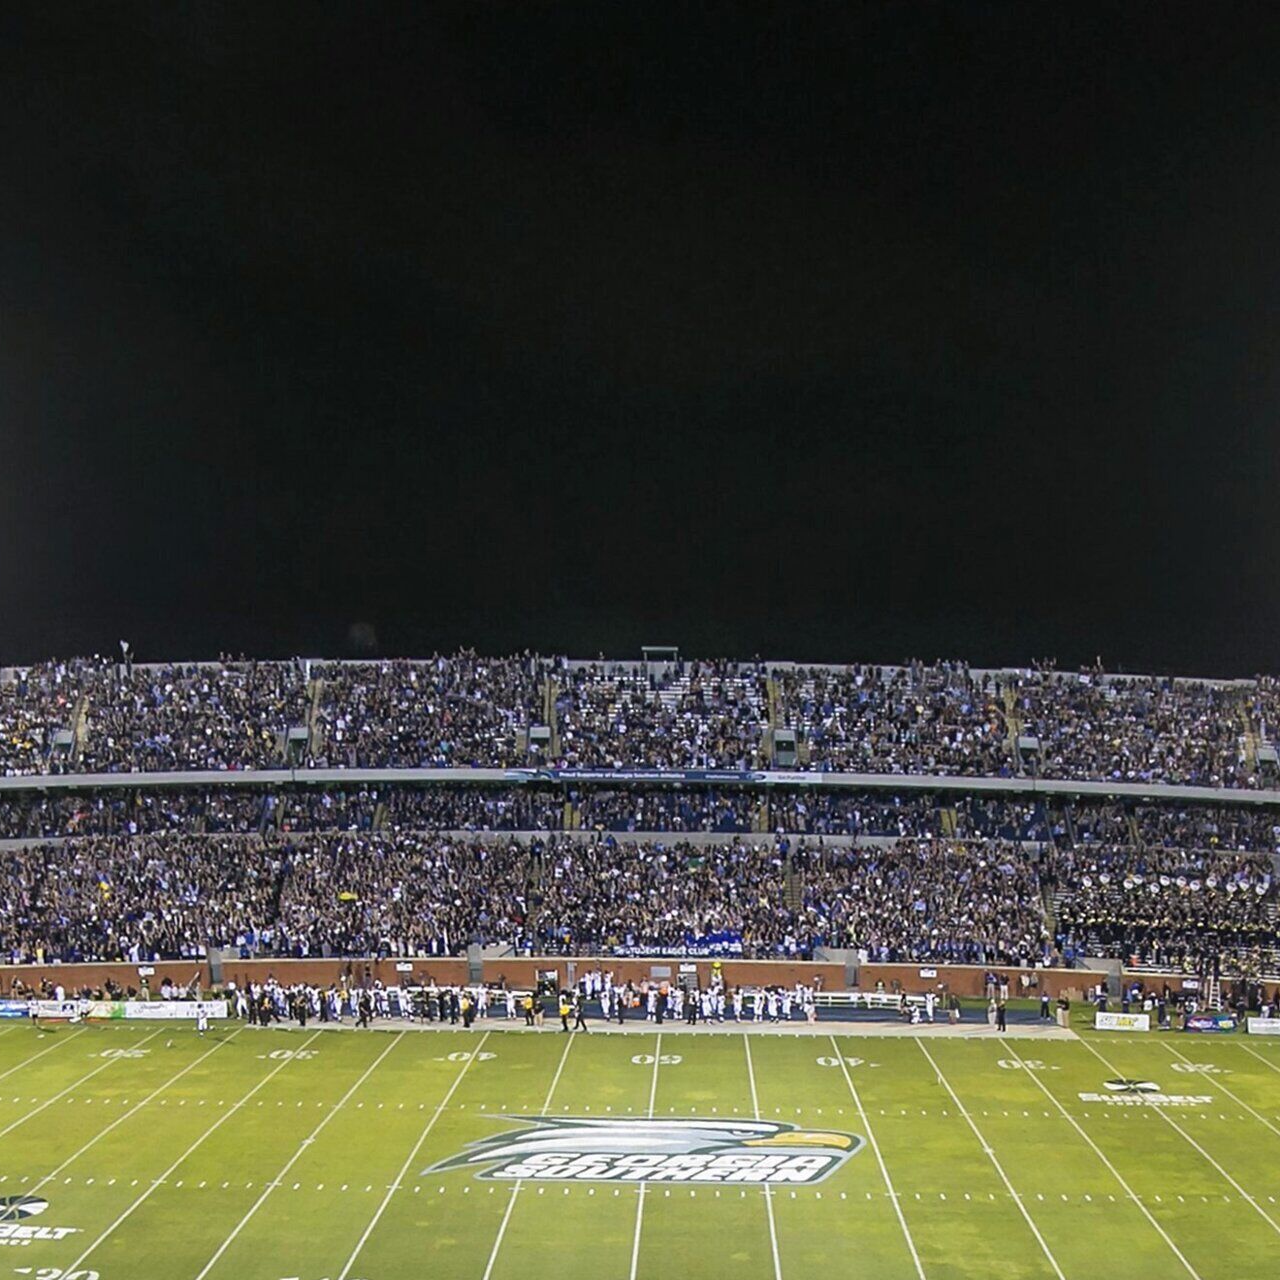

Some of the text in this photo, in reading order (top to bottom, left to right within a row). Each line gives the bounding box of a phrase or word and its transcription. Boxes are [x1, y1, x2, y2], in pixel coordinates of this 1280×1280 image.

[631, 1054, 682, 1065] 50
[816, 1055, 865, 1067] 40
[520, 1153, 833, 1169] GEORGIA
[502, 1165, 821, 1182] SOUTHERN
